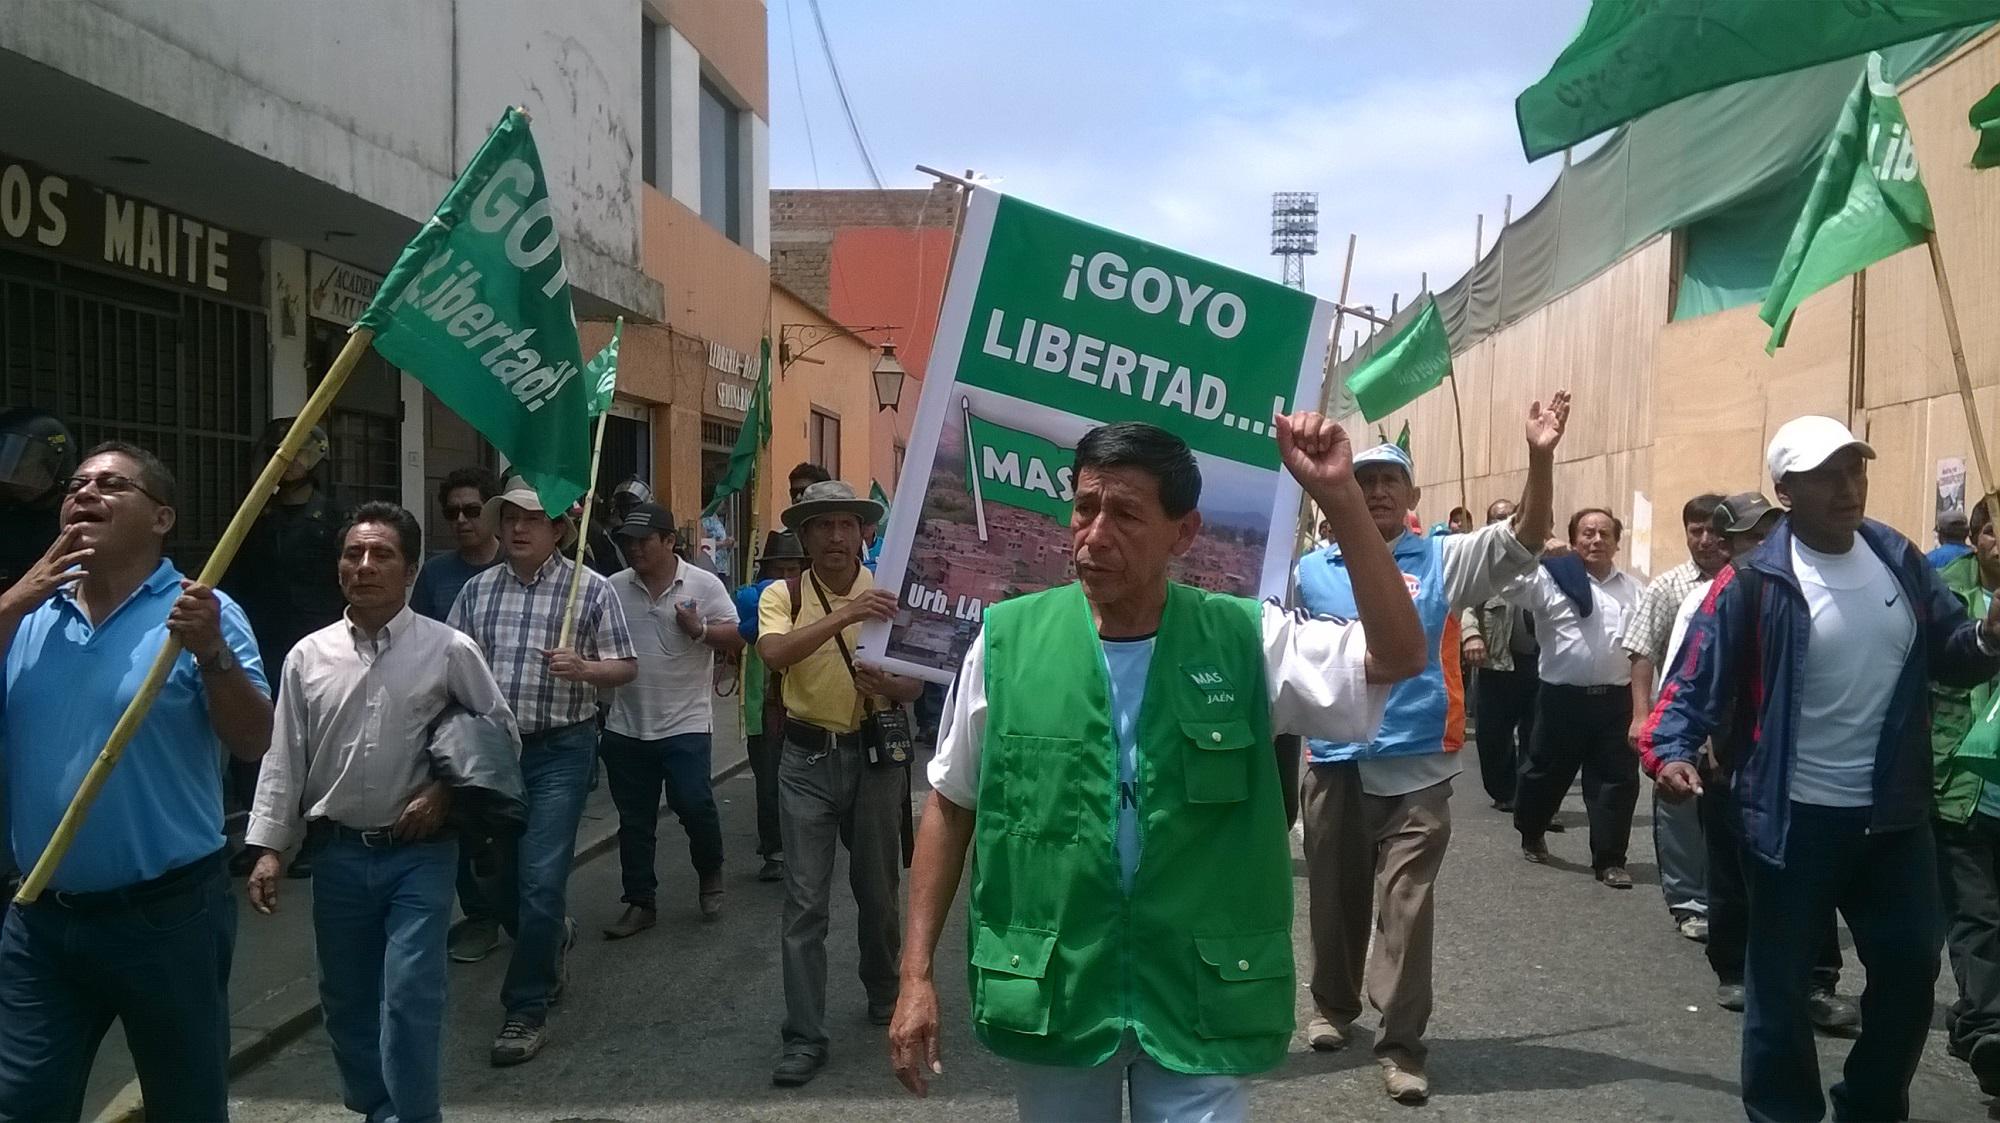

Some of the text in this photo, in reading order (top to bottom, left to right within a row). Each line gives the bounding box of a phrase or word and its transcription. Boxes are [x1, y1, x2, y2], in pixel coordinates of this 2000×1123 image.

[104, 194, 228, 292] MAITE
[1062, 251, 1247, 340] ¡GOYO
[982, 445, 1075, 502] MAS
[907, 582, 982, 623] Urb. LA
[1190, 672, 1223, 685] MAS
[1207, 691, 1235, 705] JAÉN
